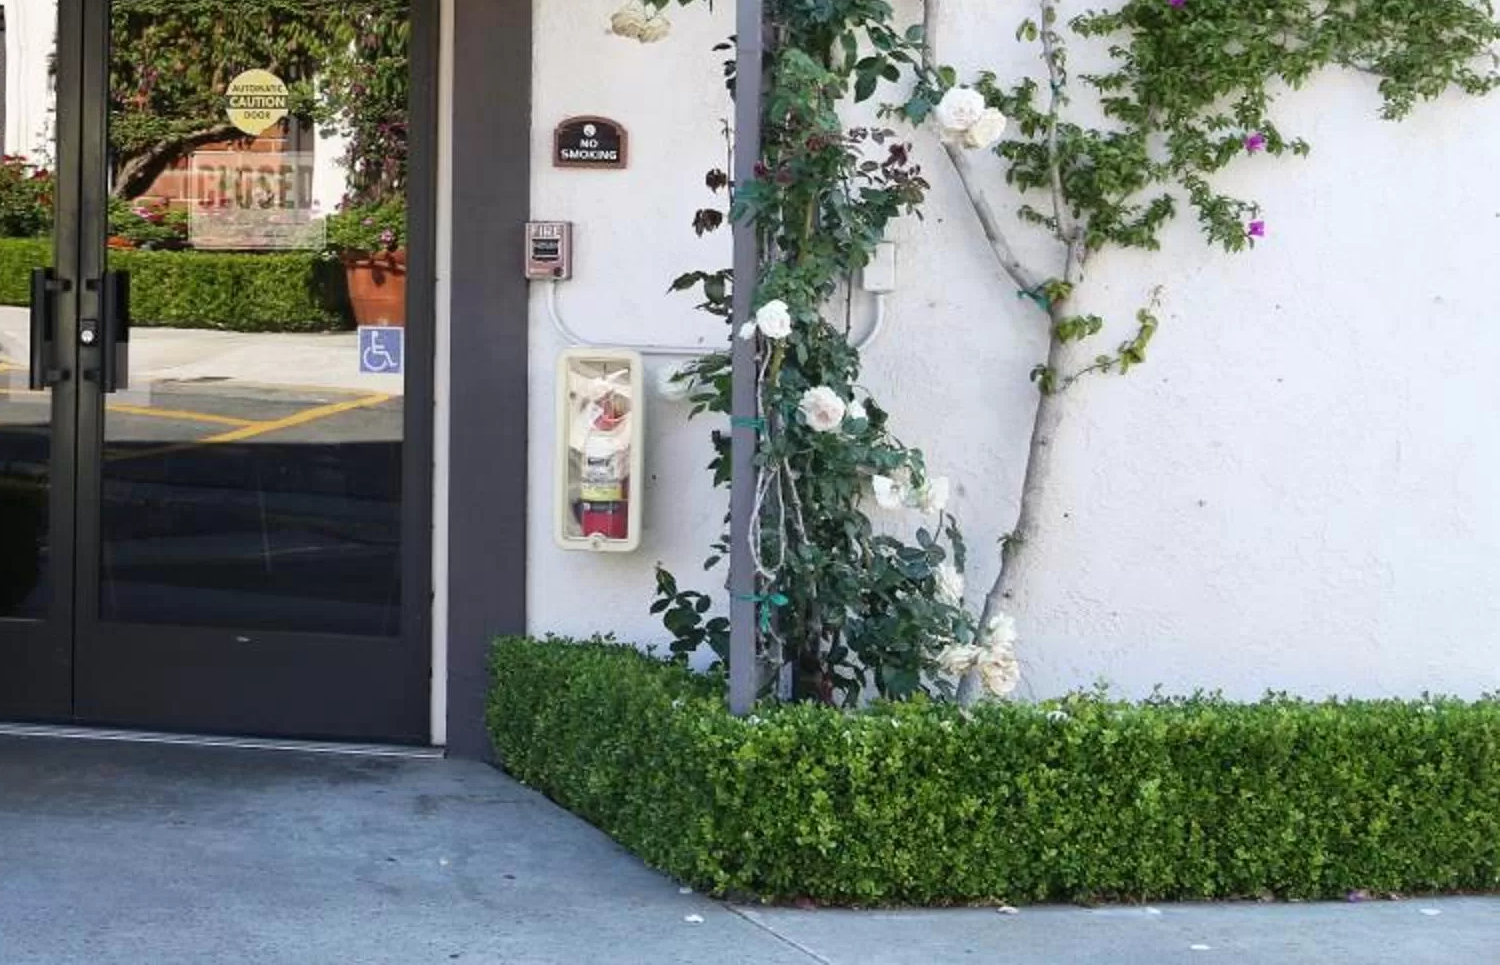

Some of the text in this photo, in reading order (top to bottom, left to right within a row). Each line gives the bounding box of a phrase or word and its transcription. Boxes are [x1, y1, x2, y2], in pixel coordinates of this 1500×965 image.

[232, 84, 283, 93] AUTOMATIC
[229, 96, 285, 108] CAUTION
[243, 110, 271, 119] DOOR
[579, 139, 599, 148] NO
[560, 149, 618, 160] SMOKING
